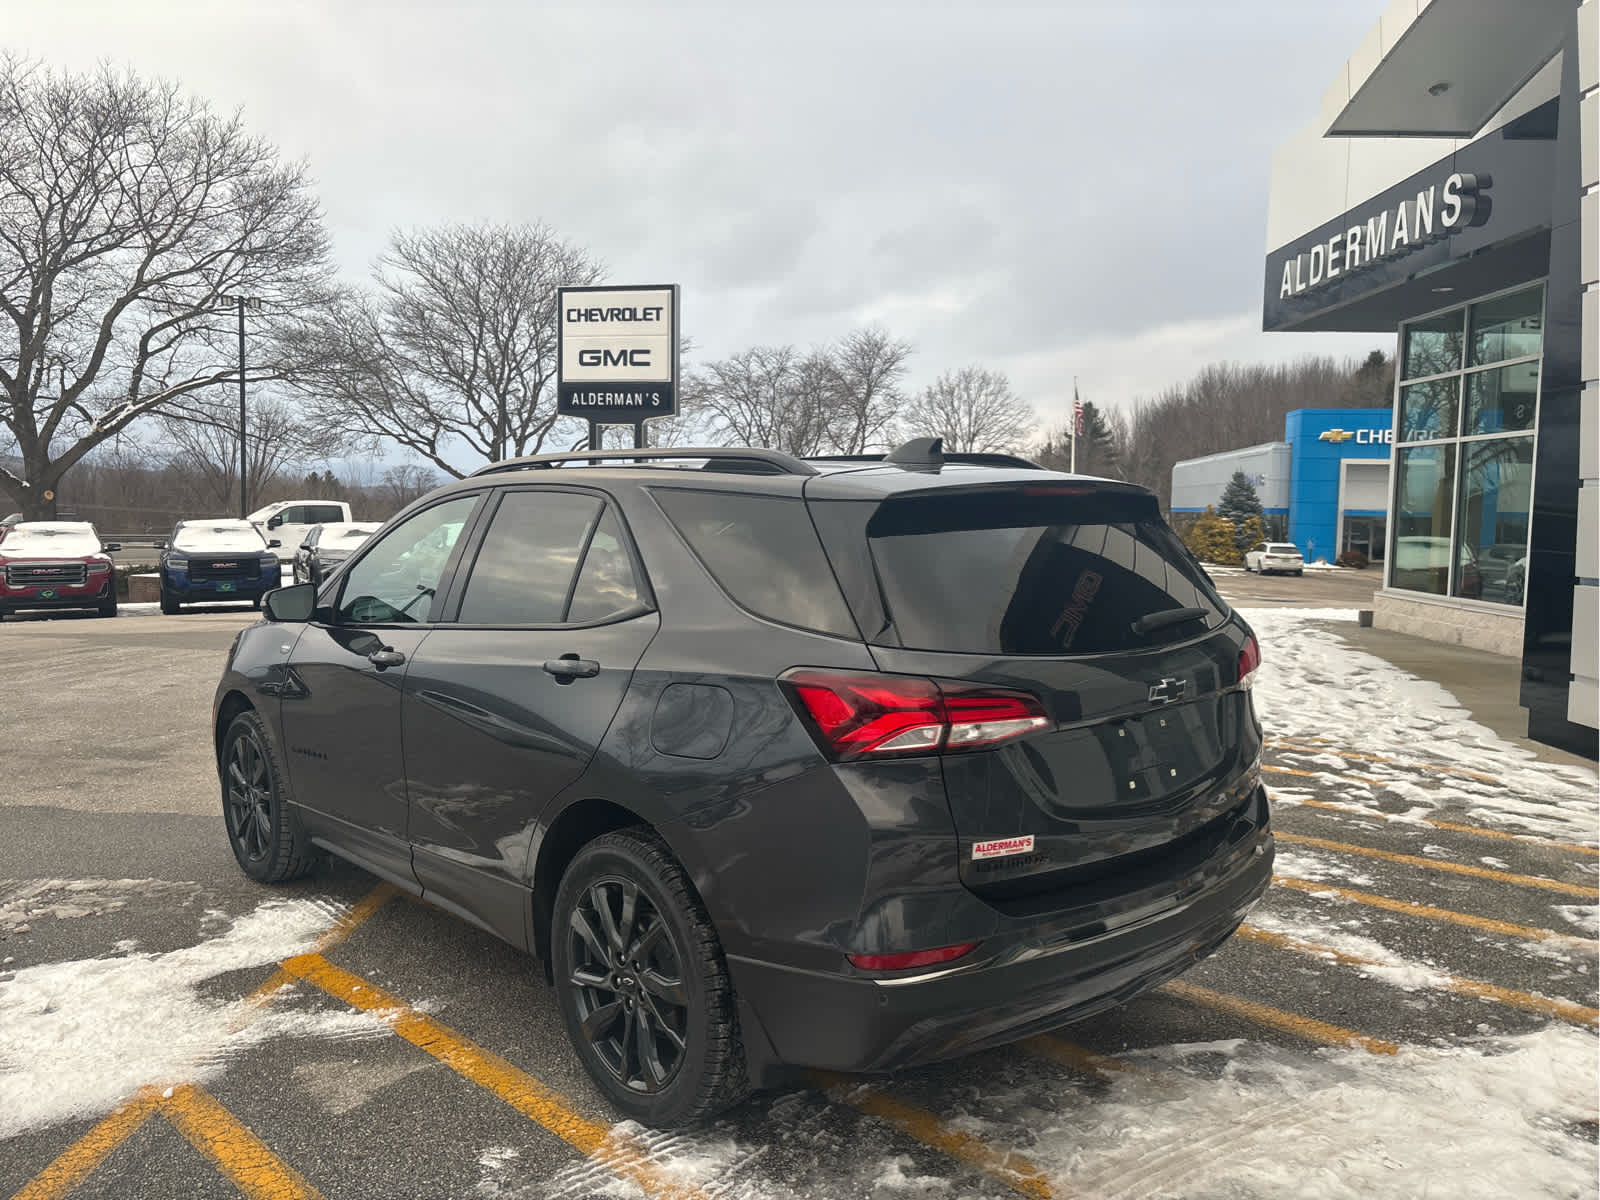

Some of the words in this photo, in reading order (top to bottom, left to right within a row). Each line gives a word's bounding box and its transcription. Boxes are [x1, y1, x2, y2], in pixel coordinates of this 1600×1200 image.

[567, 307, 664, 323] CHEVROLET
[578, 349, 651, 367] GMC
[571, 392, 660, 406] ALDERMAN'S
[975, 837, 1033, 852] ALDERMAN'S
